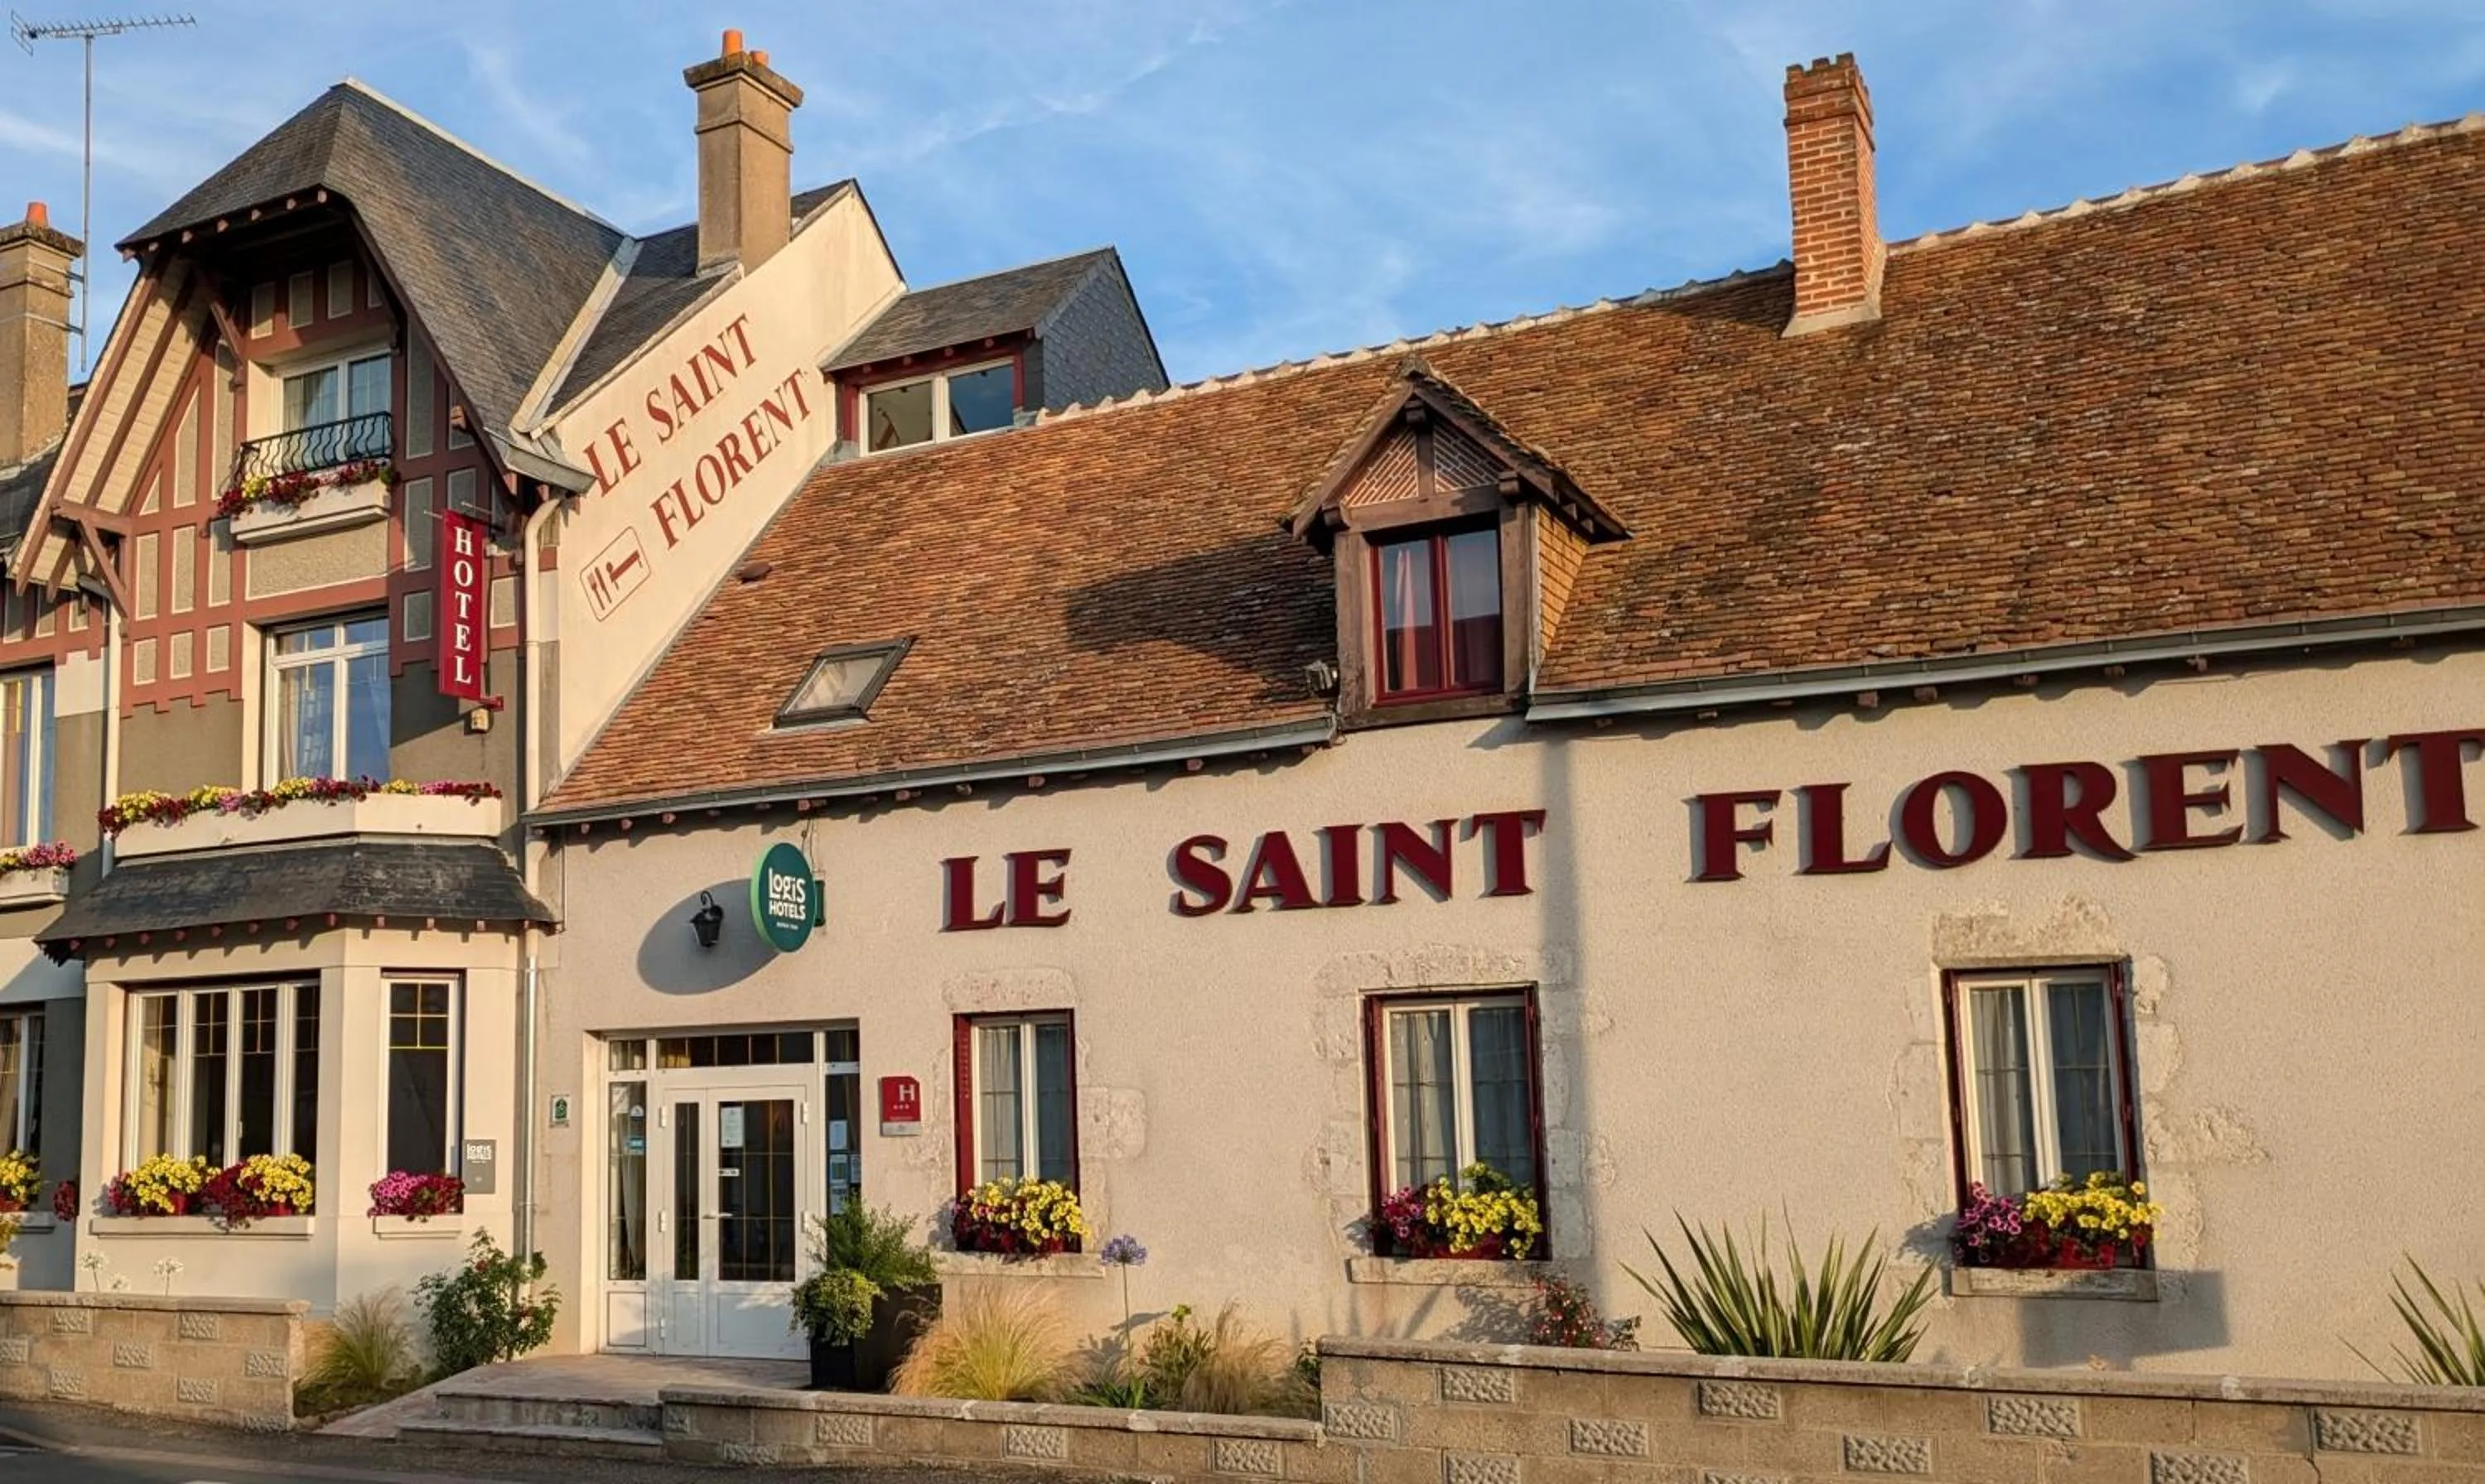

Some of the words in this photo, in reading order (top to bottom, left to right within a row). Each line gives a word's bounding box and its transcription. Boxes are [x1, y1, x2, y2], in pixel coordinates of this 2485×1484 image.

[583, 418, 641, 497] LE
[646, 313, 756, 445] SAINT
[649, 369, 811, 551] FLORENT
[453, 526, 474, 684] HOTEL
[768, 900, 806, 920] HOTELS
[939, 847, 1072, 932] LE
[1169, 809, 1546, 918] SAINT
[1685, 728, 2485, 884] FLORENT
[898, 1084, 915, 1101] H
